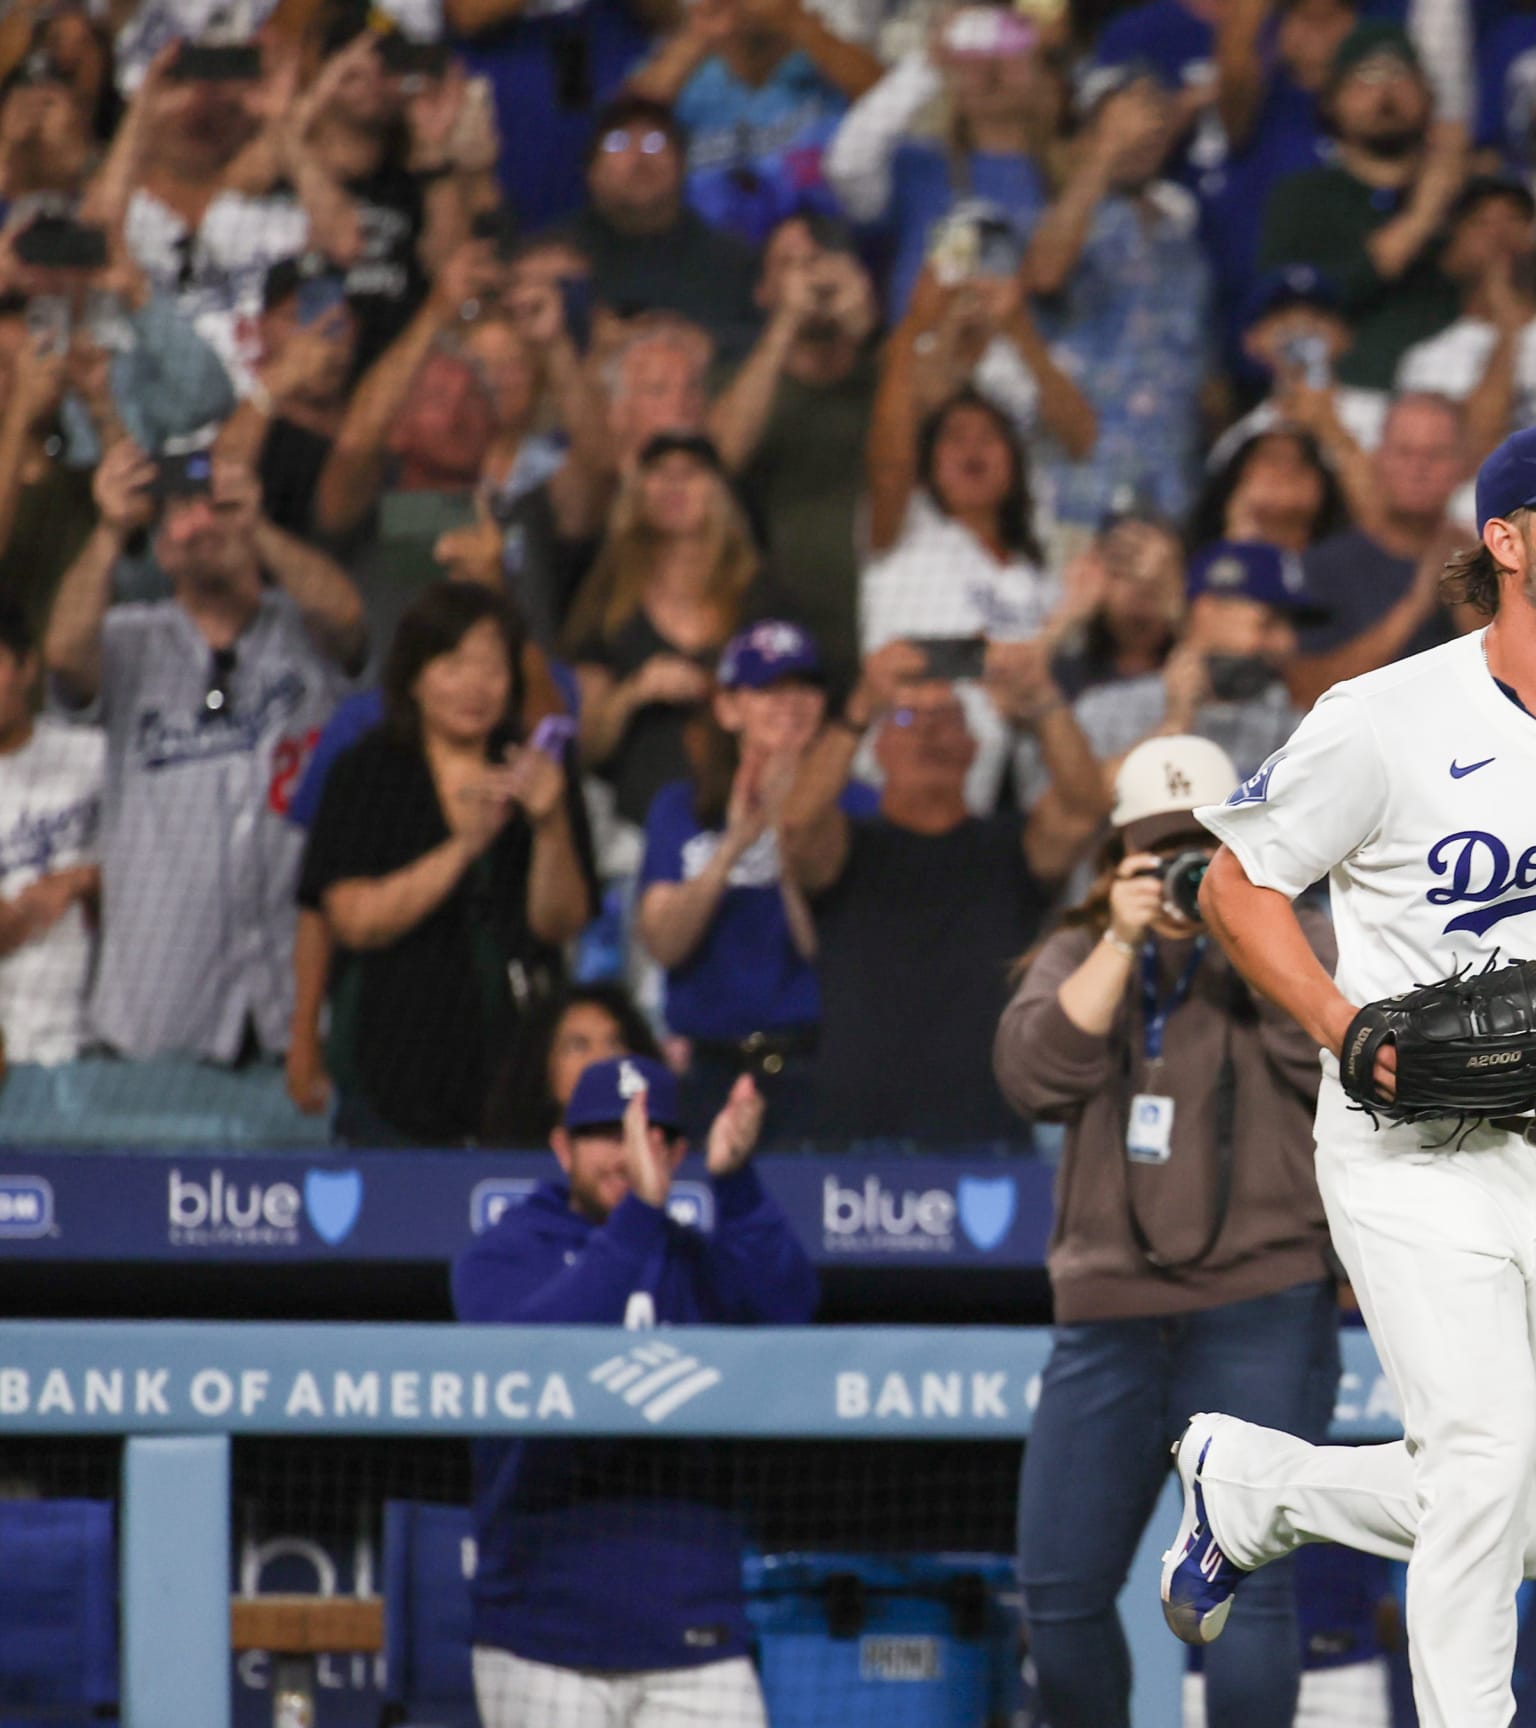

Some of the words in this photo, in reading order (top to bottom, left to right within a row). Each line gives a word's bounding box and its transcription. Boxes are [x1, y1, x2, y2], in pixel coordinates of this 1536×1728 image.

[1465, 1049, 1521, 1068] A2000
[169, 1168, 299, 1228] blue
[823, 1174, 956, 1235] blue
[0, 1368, 170, 1415] BANK
[190, 1369, 269, 1417] OF
[286, 1372, 575, 1419] AMERICA
[836, 1371, 1008, 1419] BANK
